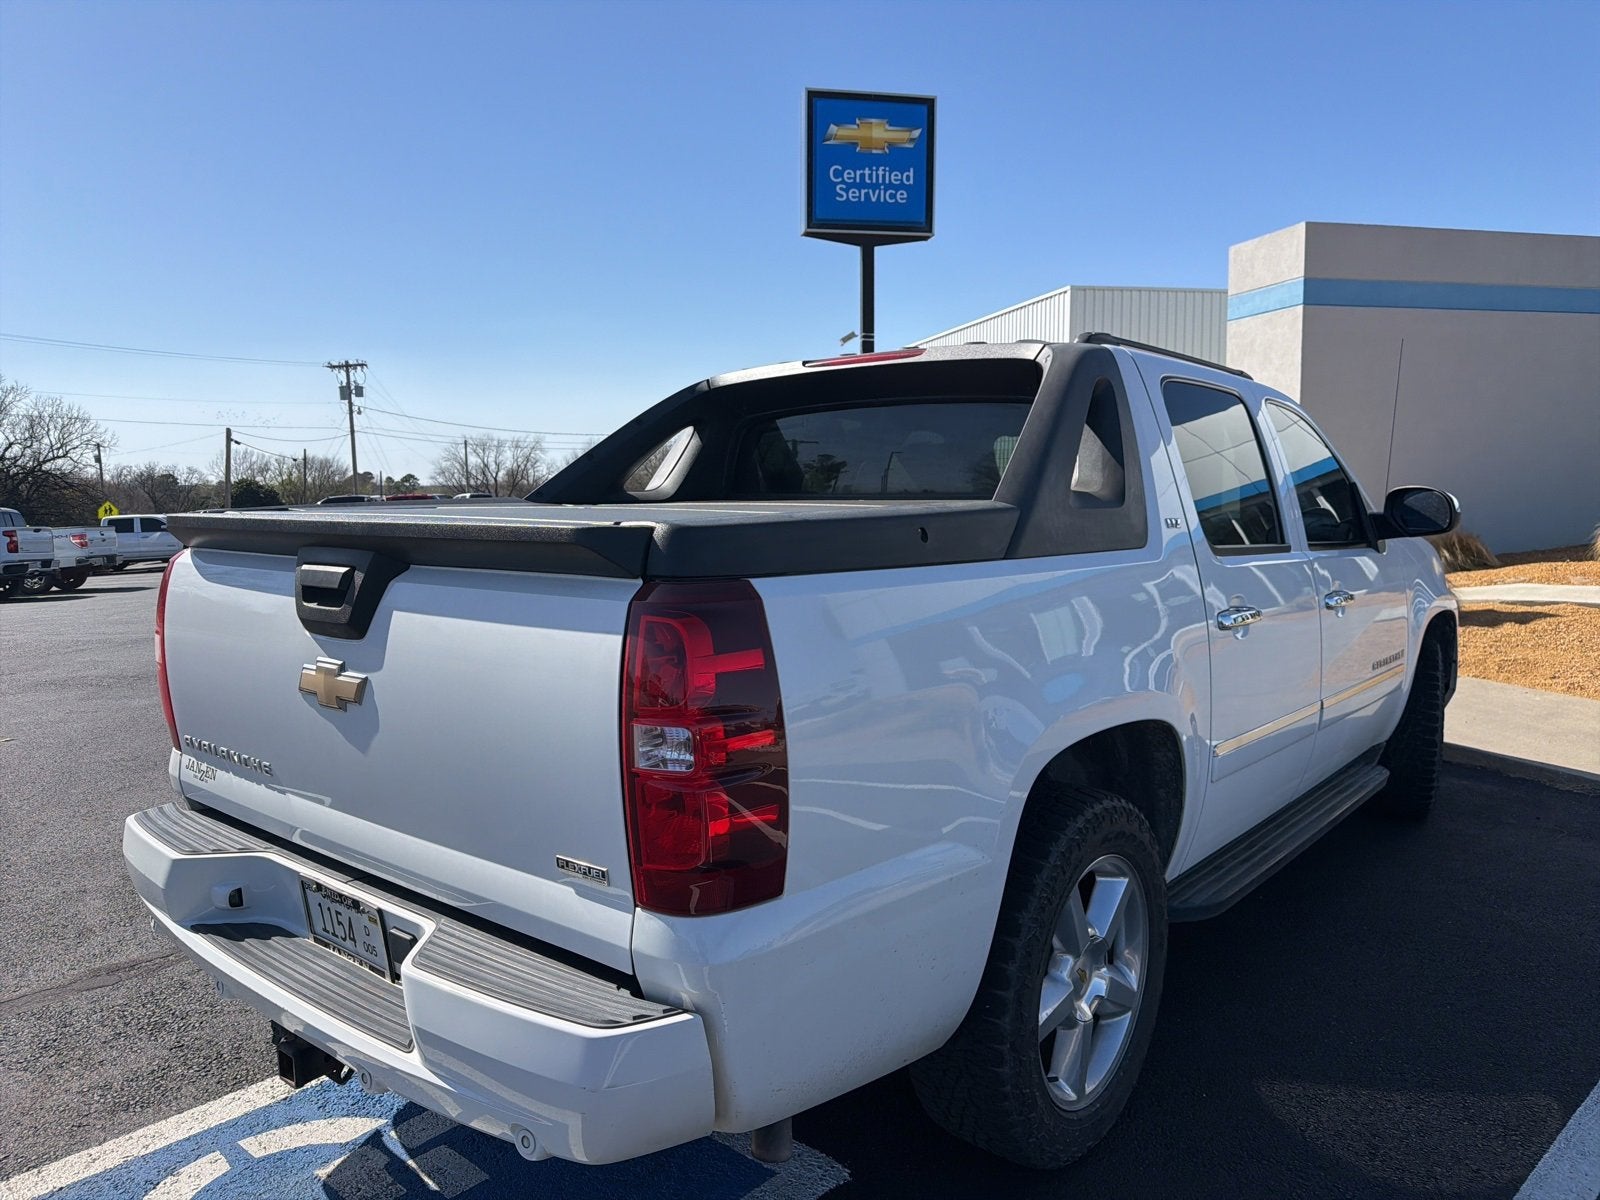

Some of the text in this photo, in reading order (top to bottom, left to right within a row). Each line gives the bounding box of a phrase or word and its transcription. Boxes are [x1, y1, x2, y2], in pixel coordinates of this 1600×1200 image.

[829, 165, 914, 185] Certified
[835, 184, 908, 203] Service
[183, 734, 274, 777] AVALANCHE
[185, 758, 218, 782] JANZEN
[558, 859, 606, 881] FLEXFUEL
[318, 902, 357, 948] 1154
[363, 941, 378, 957] 005
